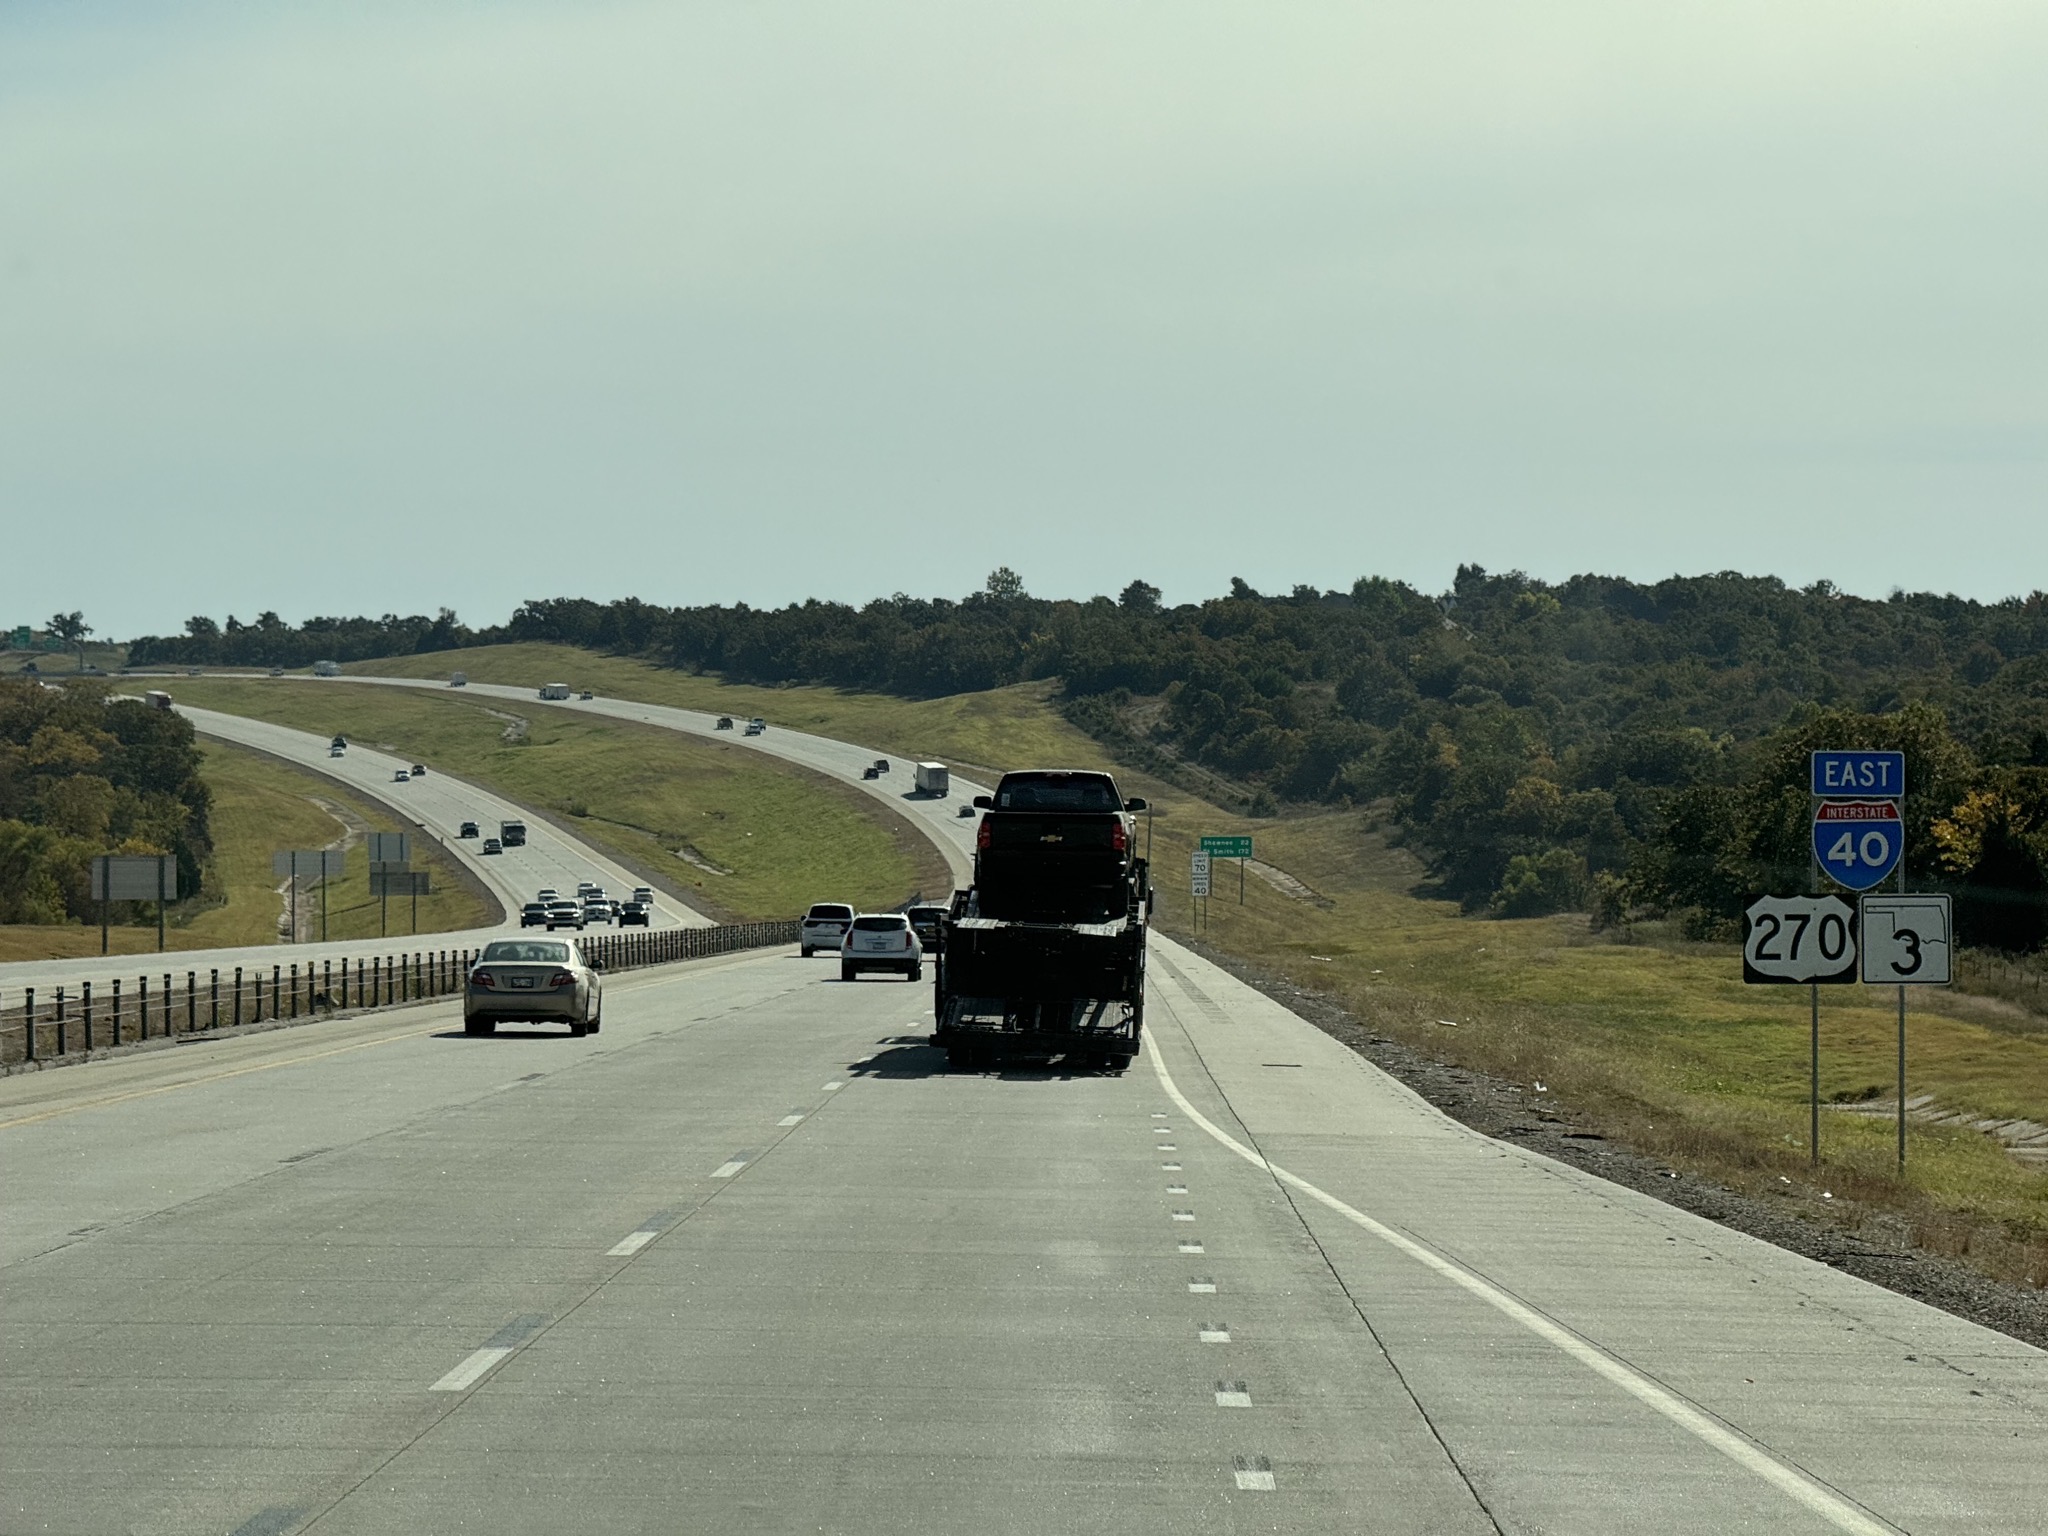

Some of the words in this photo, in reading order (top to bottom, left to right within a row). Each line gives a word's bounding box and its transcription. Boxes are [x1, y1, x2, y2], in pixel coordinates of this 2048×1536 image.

[1825, 761, 1891, 787] EAST
[1826, 806, 1889, 819] INTERSTATE
[1827, 831, 1889, 867] 40
[1755, 913, 1846, 961] 270
[1890, 928, 1922, 975] 3
